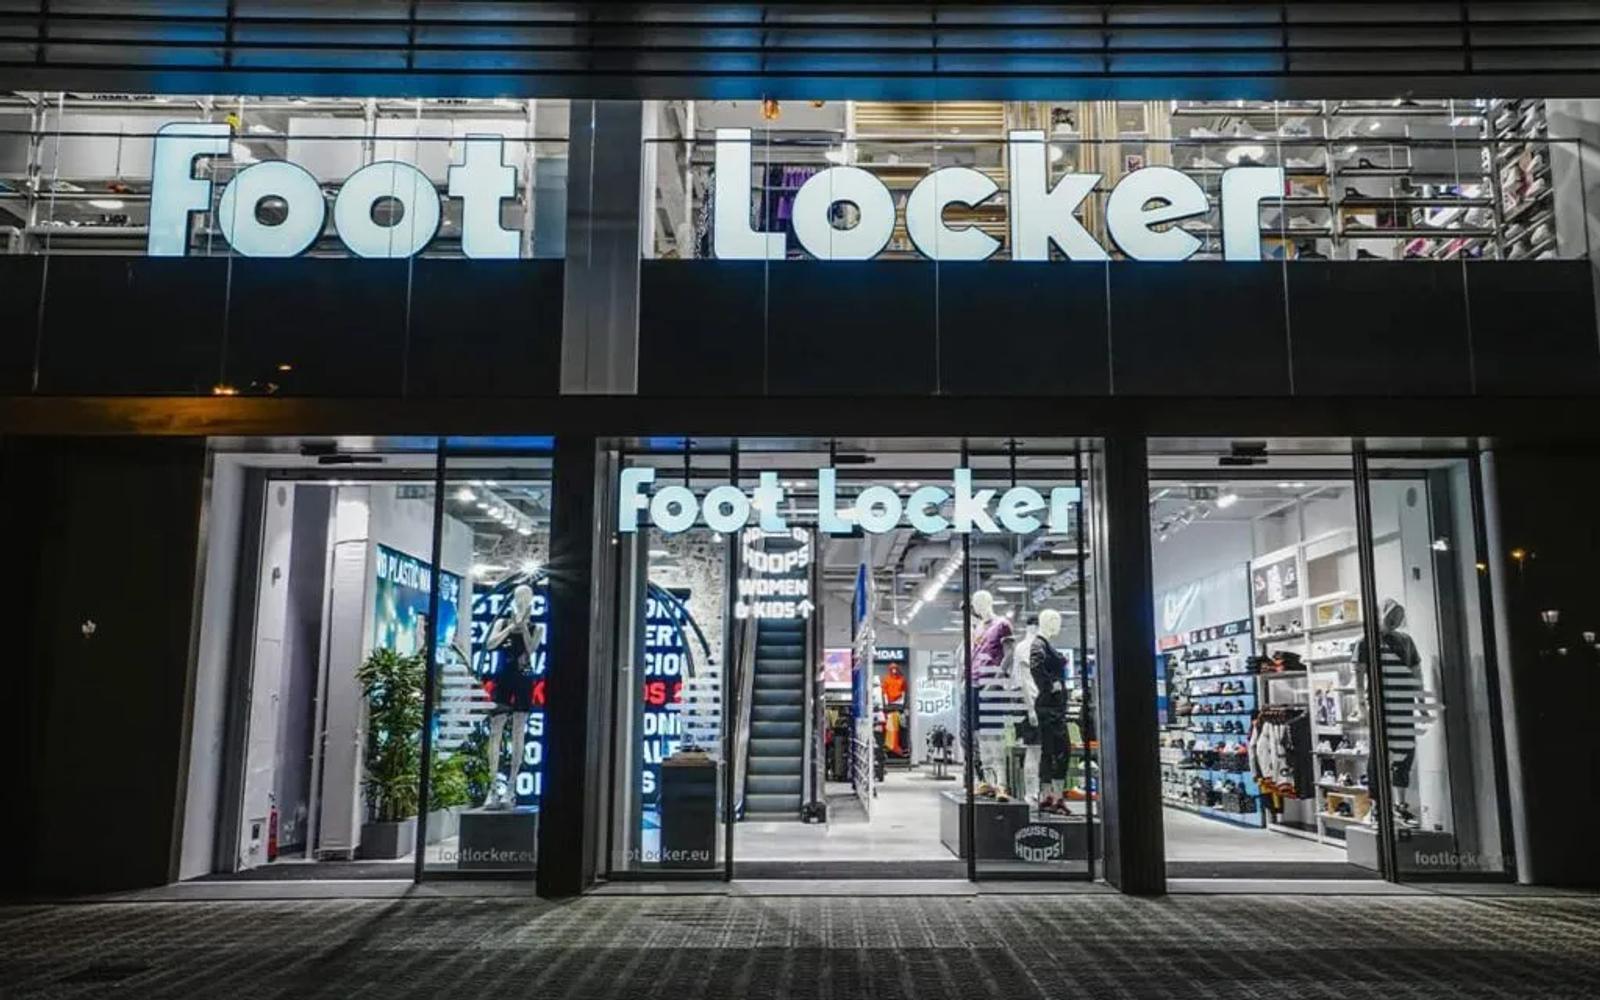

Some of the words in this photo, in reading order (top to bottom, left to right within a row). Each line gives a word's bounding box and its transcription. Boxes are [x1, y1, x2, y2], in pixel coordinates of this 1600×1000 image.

[148, 122, 521, 259] Foot
[713, 127, 1284, 261] Locker
[619, 467, 788, 534] Foot
[818, 468, 1081, 534] Locker
[738, 578, 809, 596] WOMEN
[753, 601, 796, 618] KIDS
[1015, 840, 1061, 862] HOOPS
